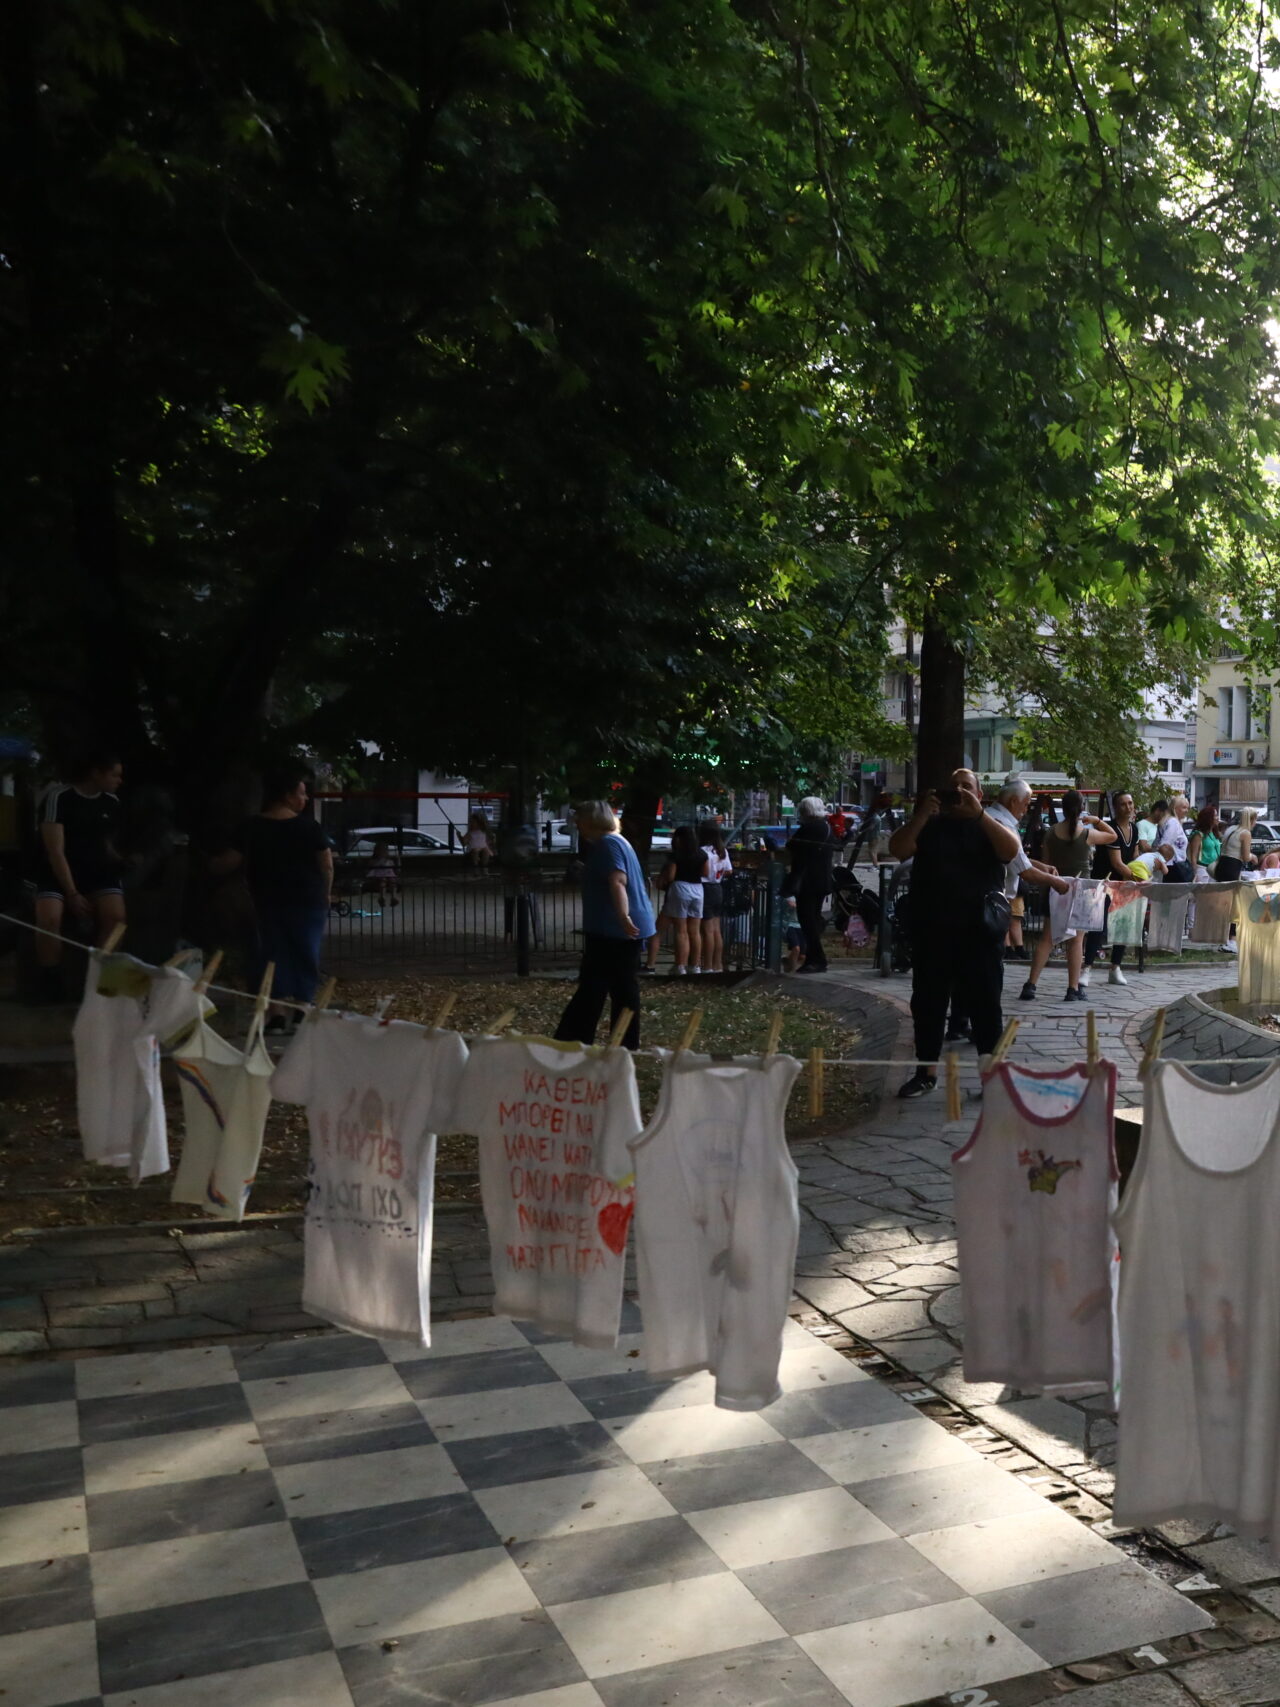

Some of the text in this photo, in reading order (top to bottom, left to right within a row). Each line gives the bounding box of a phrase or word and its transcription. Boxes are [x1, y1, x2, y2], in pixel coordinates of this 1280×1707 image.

[523, 1069, 609, 1106] ΚΑΘΕΝΑ
[498, 1101, 593, 1138] ΜΠΟΡΕΙ ΝΑ
[503, 1132, 556, 1162] ΚΑΝΕΙ
